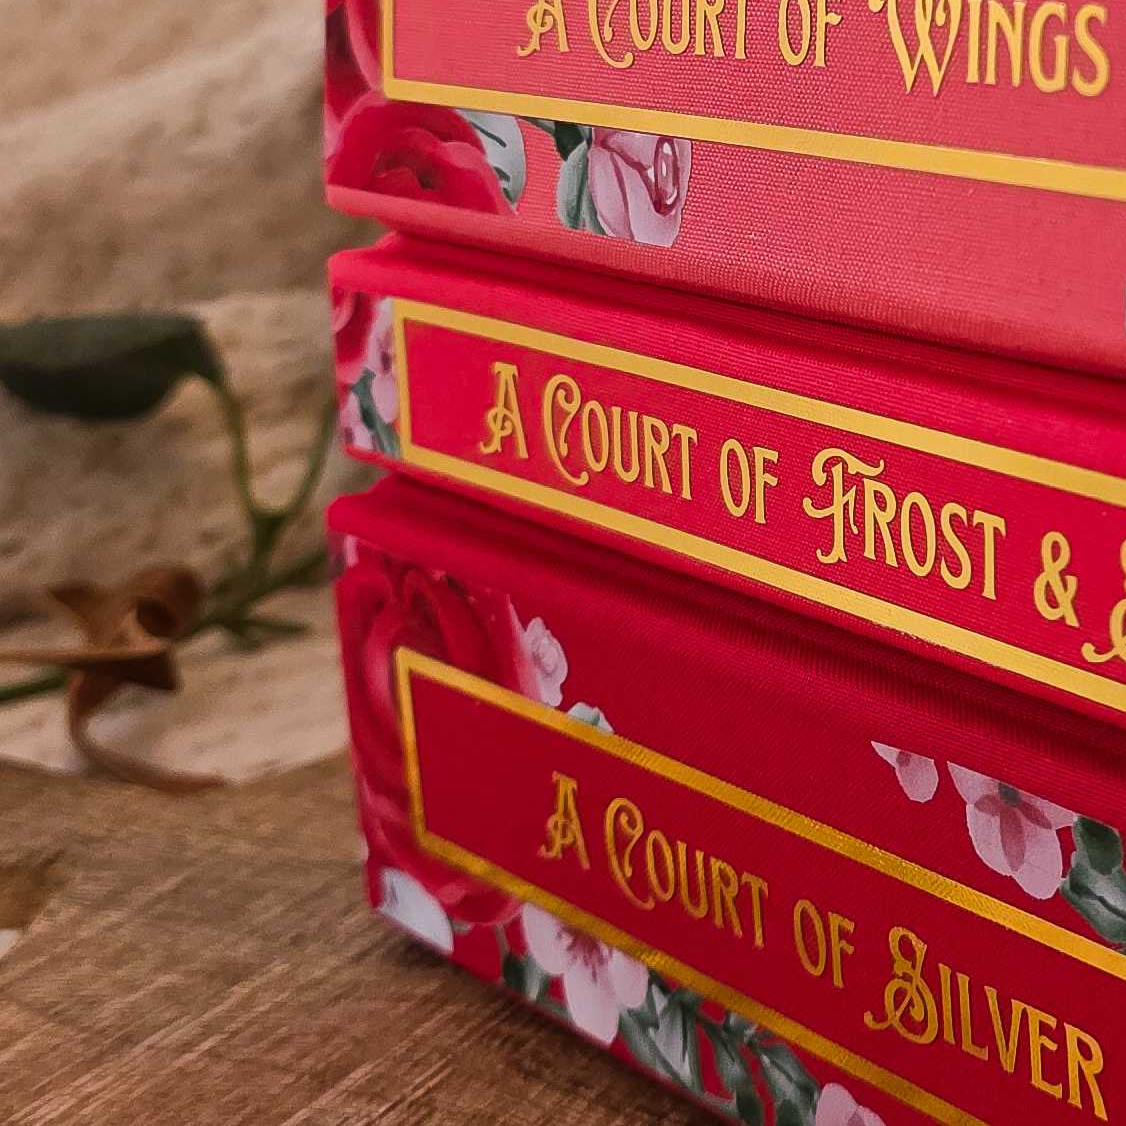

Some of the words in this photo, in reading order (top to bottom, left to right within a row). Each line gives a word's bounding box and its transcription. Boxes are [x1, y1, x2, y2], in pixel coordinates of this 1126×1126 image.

[480, 361, 528, 459] A
[541, 374, 697, 501] COURT
[719, 436, 779, 525] OF
[802, 447, 1007, 600] FROST
[1032, 532, 1080, 629] &
[540, 771, 590, 871] A
[604, 797, 770, 950] COURT
[792, 898, 855, 990] OF
[863, 926, 1107, 1122] SILVER
